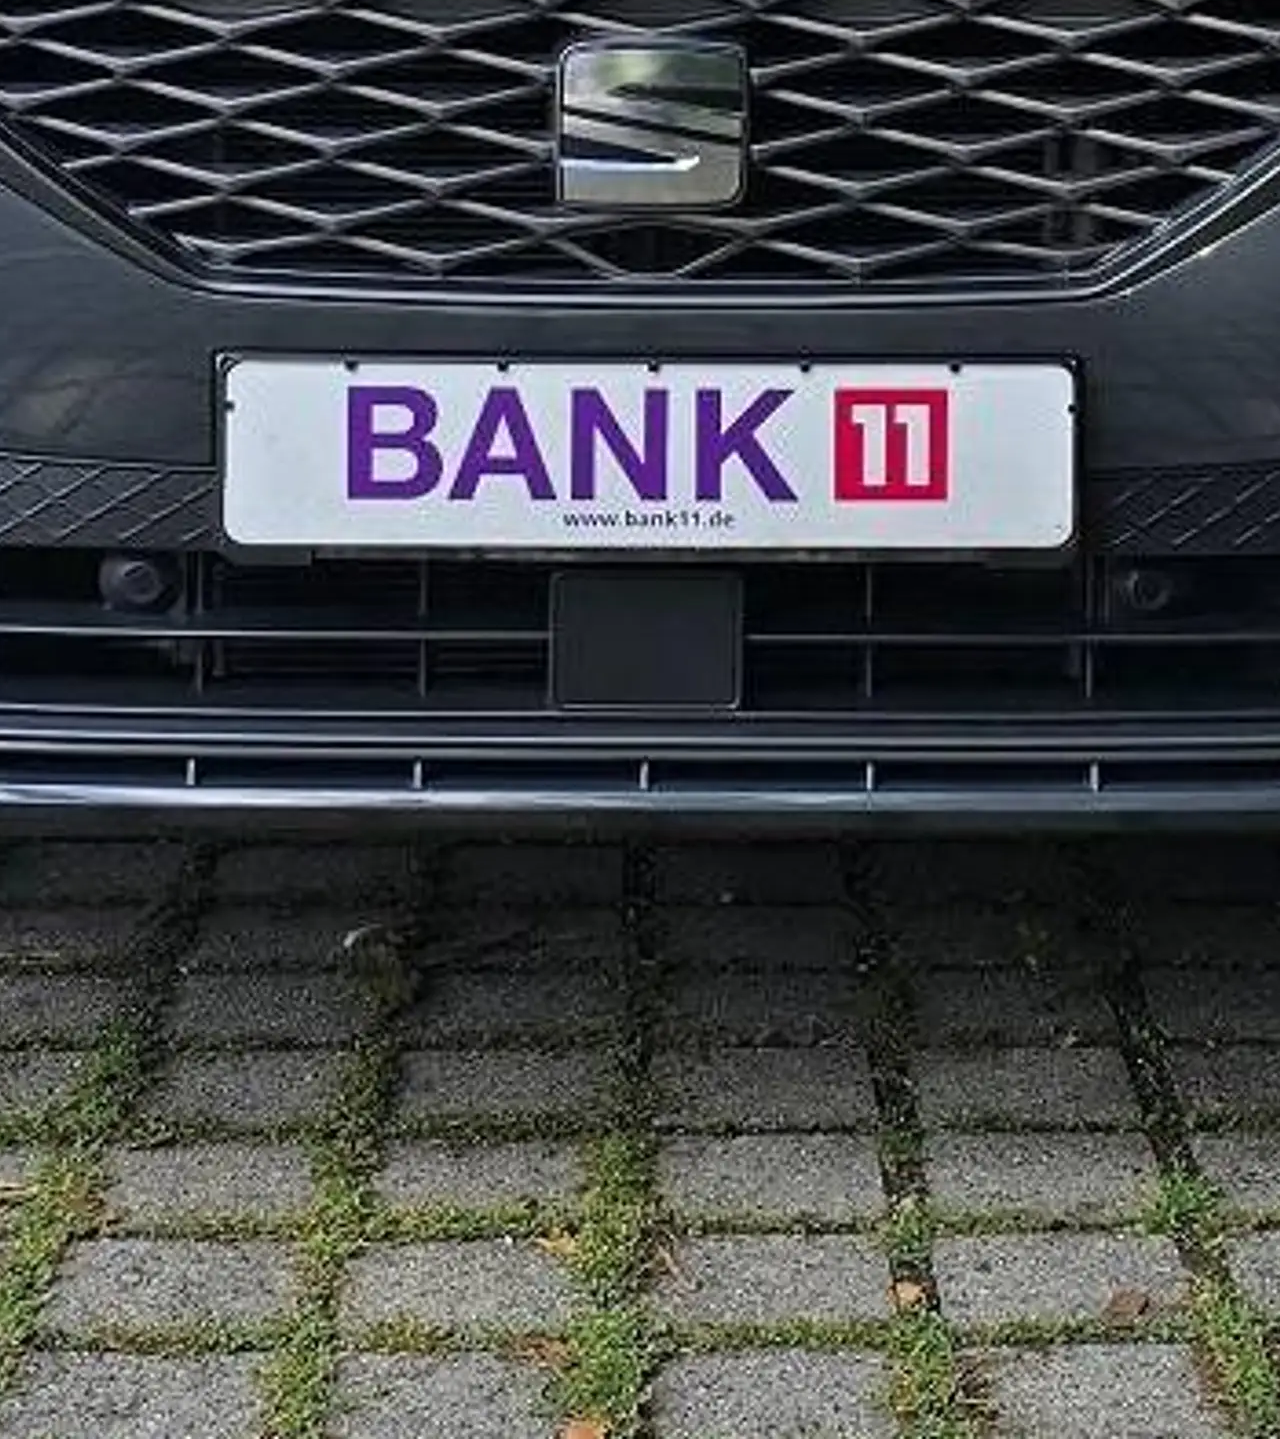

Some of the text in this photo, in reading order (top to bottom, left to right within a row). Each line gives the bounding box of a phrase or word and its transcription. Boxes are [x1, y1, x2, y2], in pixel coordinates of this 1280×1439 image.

[347, 386, 930, 501] BANK 11
[563, 510, 735, 528] www.bank11.de
